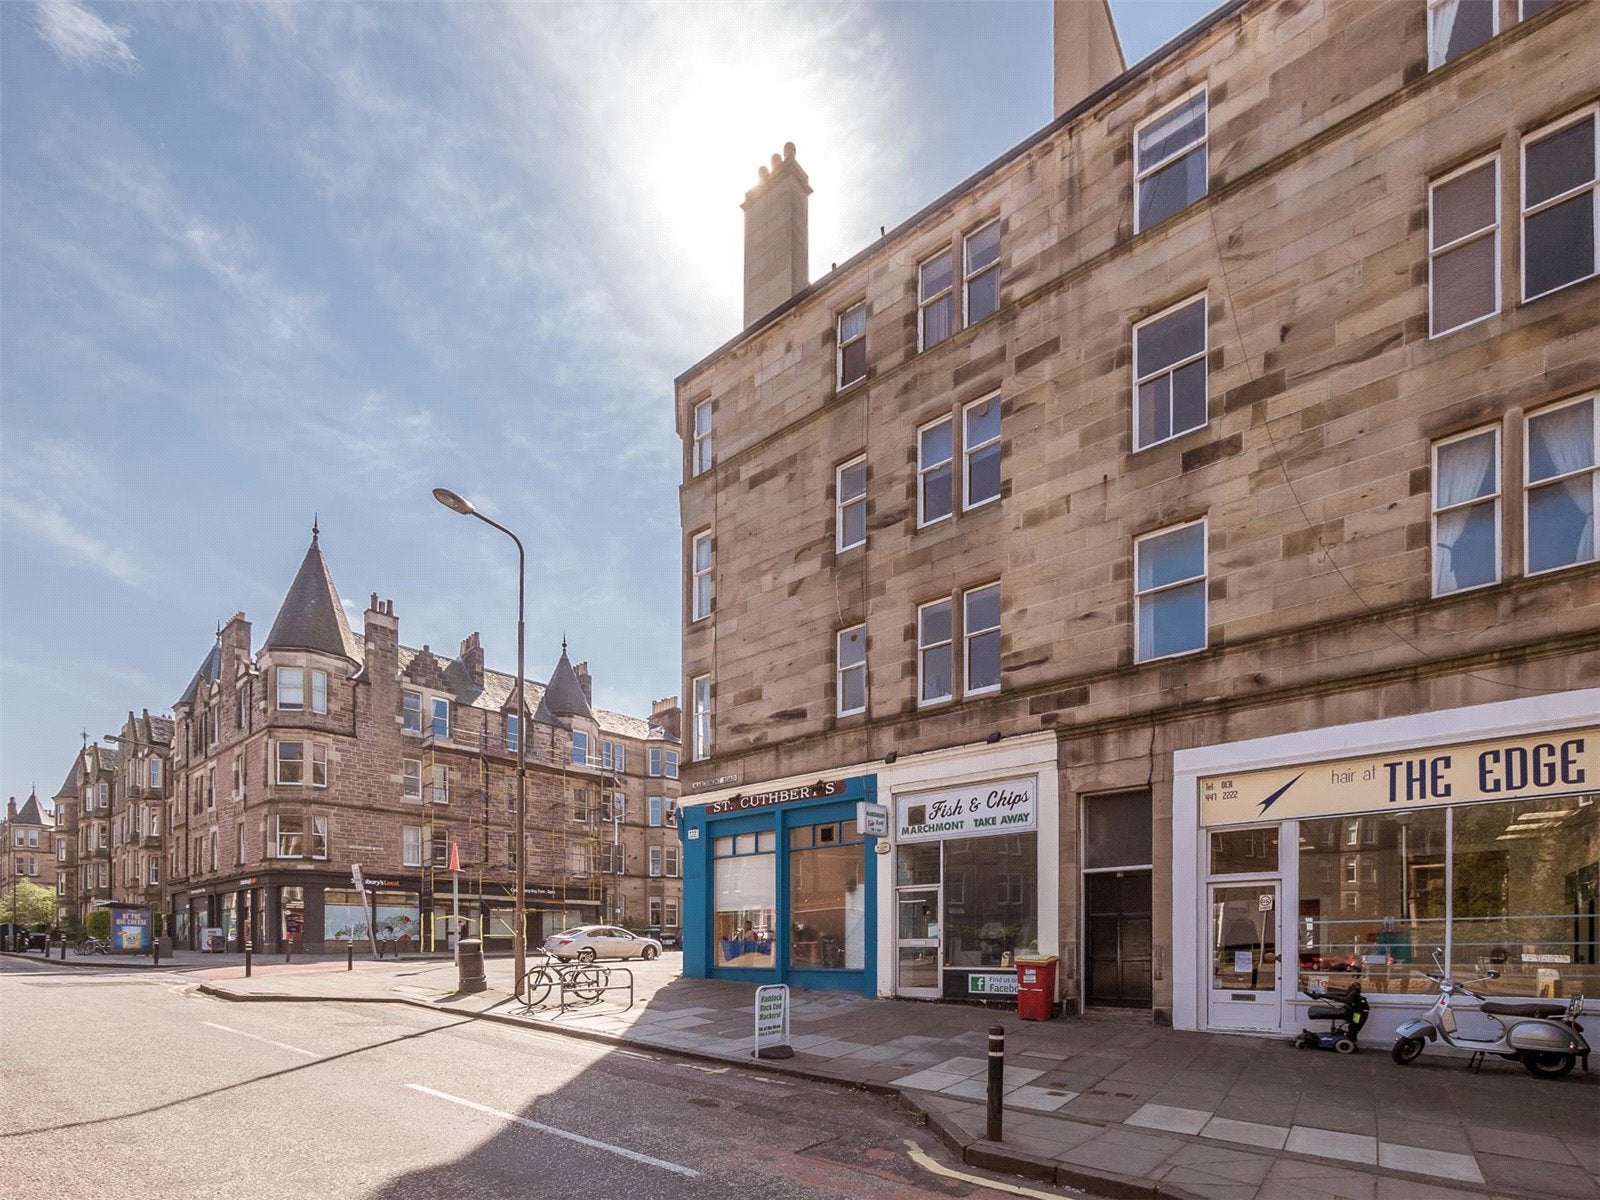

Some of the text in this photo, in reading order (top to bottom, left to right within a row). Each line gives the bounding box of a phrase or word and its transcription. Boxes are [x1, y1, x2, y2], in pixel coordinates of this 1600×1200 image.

[1331, 738, 1585, 803] hair at THE EDGE
[1221, 780, 1233, 789] 0131
[1222, 790, 1239, 800] 2222
[713, 782, 836, 814] ST. CUTHBER'S
[928, 789, 1031, 821] Fish & Chips
[901, 812, 1031, 836] MARCHMONT TAKE AWAY
[989, 984, 1018, 993] Facebo
